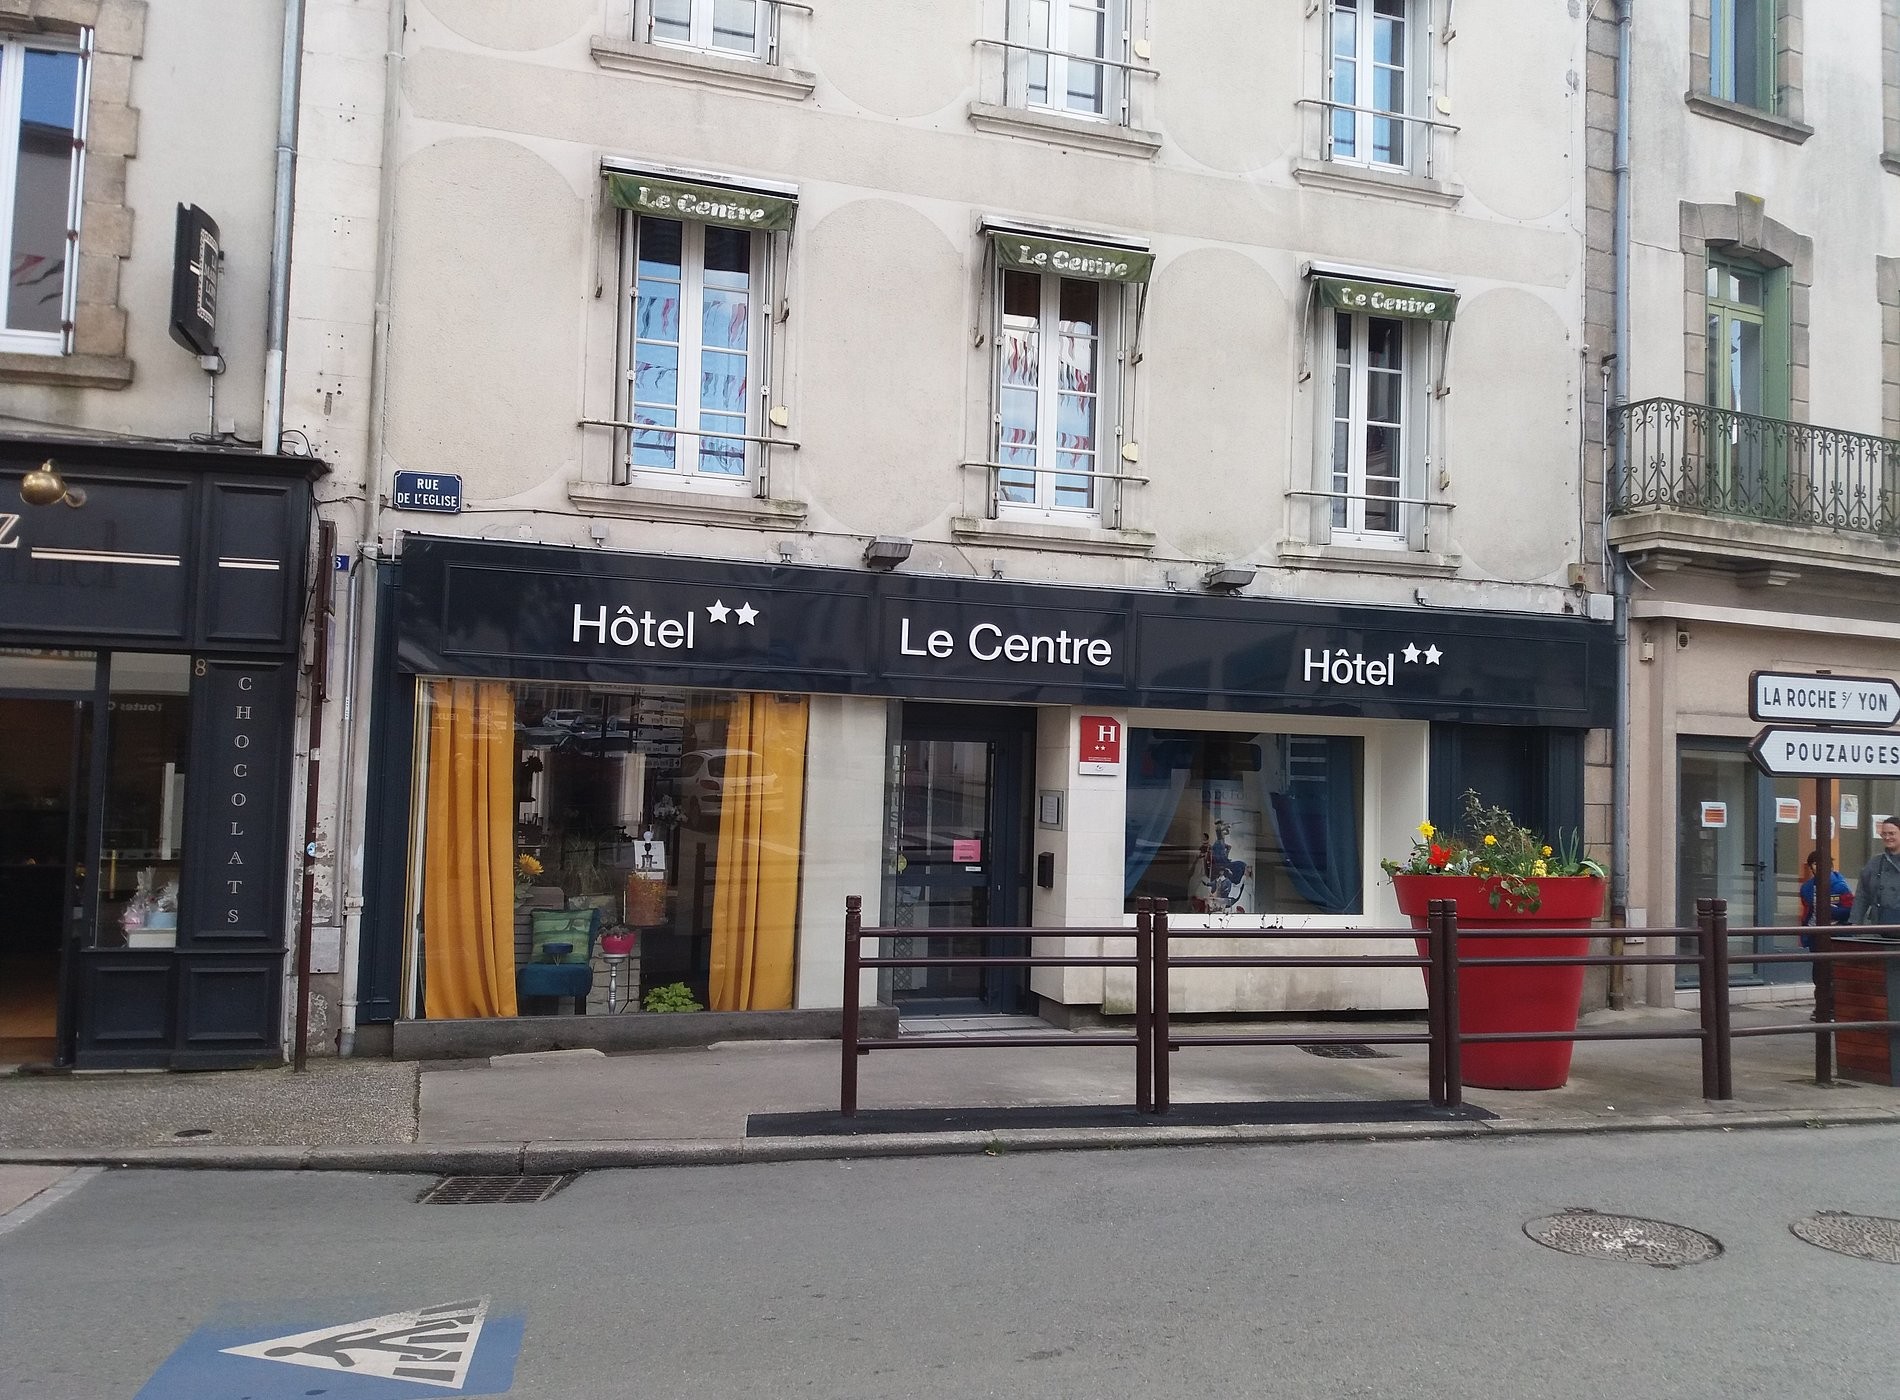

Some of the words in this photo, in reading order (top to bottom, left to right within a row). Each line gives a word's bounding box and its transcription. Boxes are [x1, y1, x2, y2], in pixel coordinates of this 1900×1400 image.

[637, 186, 671, 209] Le
[677, 193, 765, 223] Centre
[1018, 245, 1048, 265] Le
[1052, 250, 1128, 276] Centre
[1341, 287, 1367, 306] Le
[1371, 291, 1436, 314] Centre
[417, 478, 439, 490] RUE
[397, 492, 410, 504] DE
[414, 493, 457, 507] L'EGLISE
[572, 603, 695, 649] Hôtel
[900, 618, 954, 658] Le
[969, 623, 1112, 666] Centre
[194, 658, 206, 677] 8
[1303, 648, 1395, 686] Hôtel
[1764, 687, 1781, 706] LA
[1787, 688, 1837, 709] ROCHE
[1859, 692, 1888, 711] YON
[1097, 724, 1117, 743] H
[1786, 742, 1900, 765] POUZAUGES
[227, 676, 252, 924] CHOCOLATS
